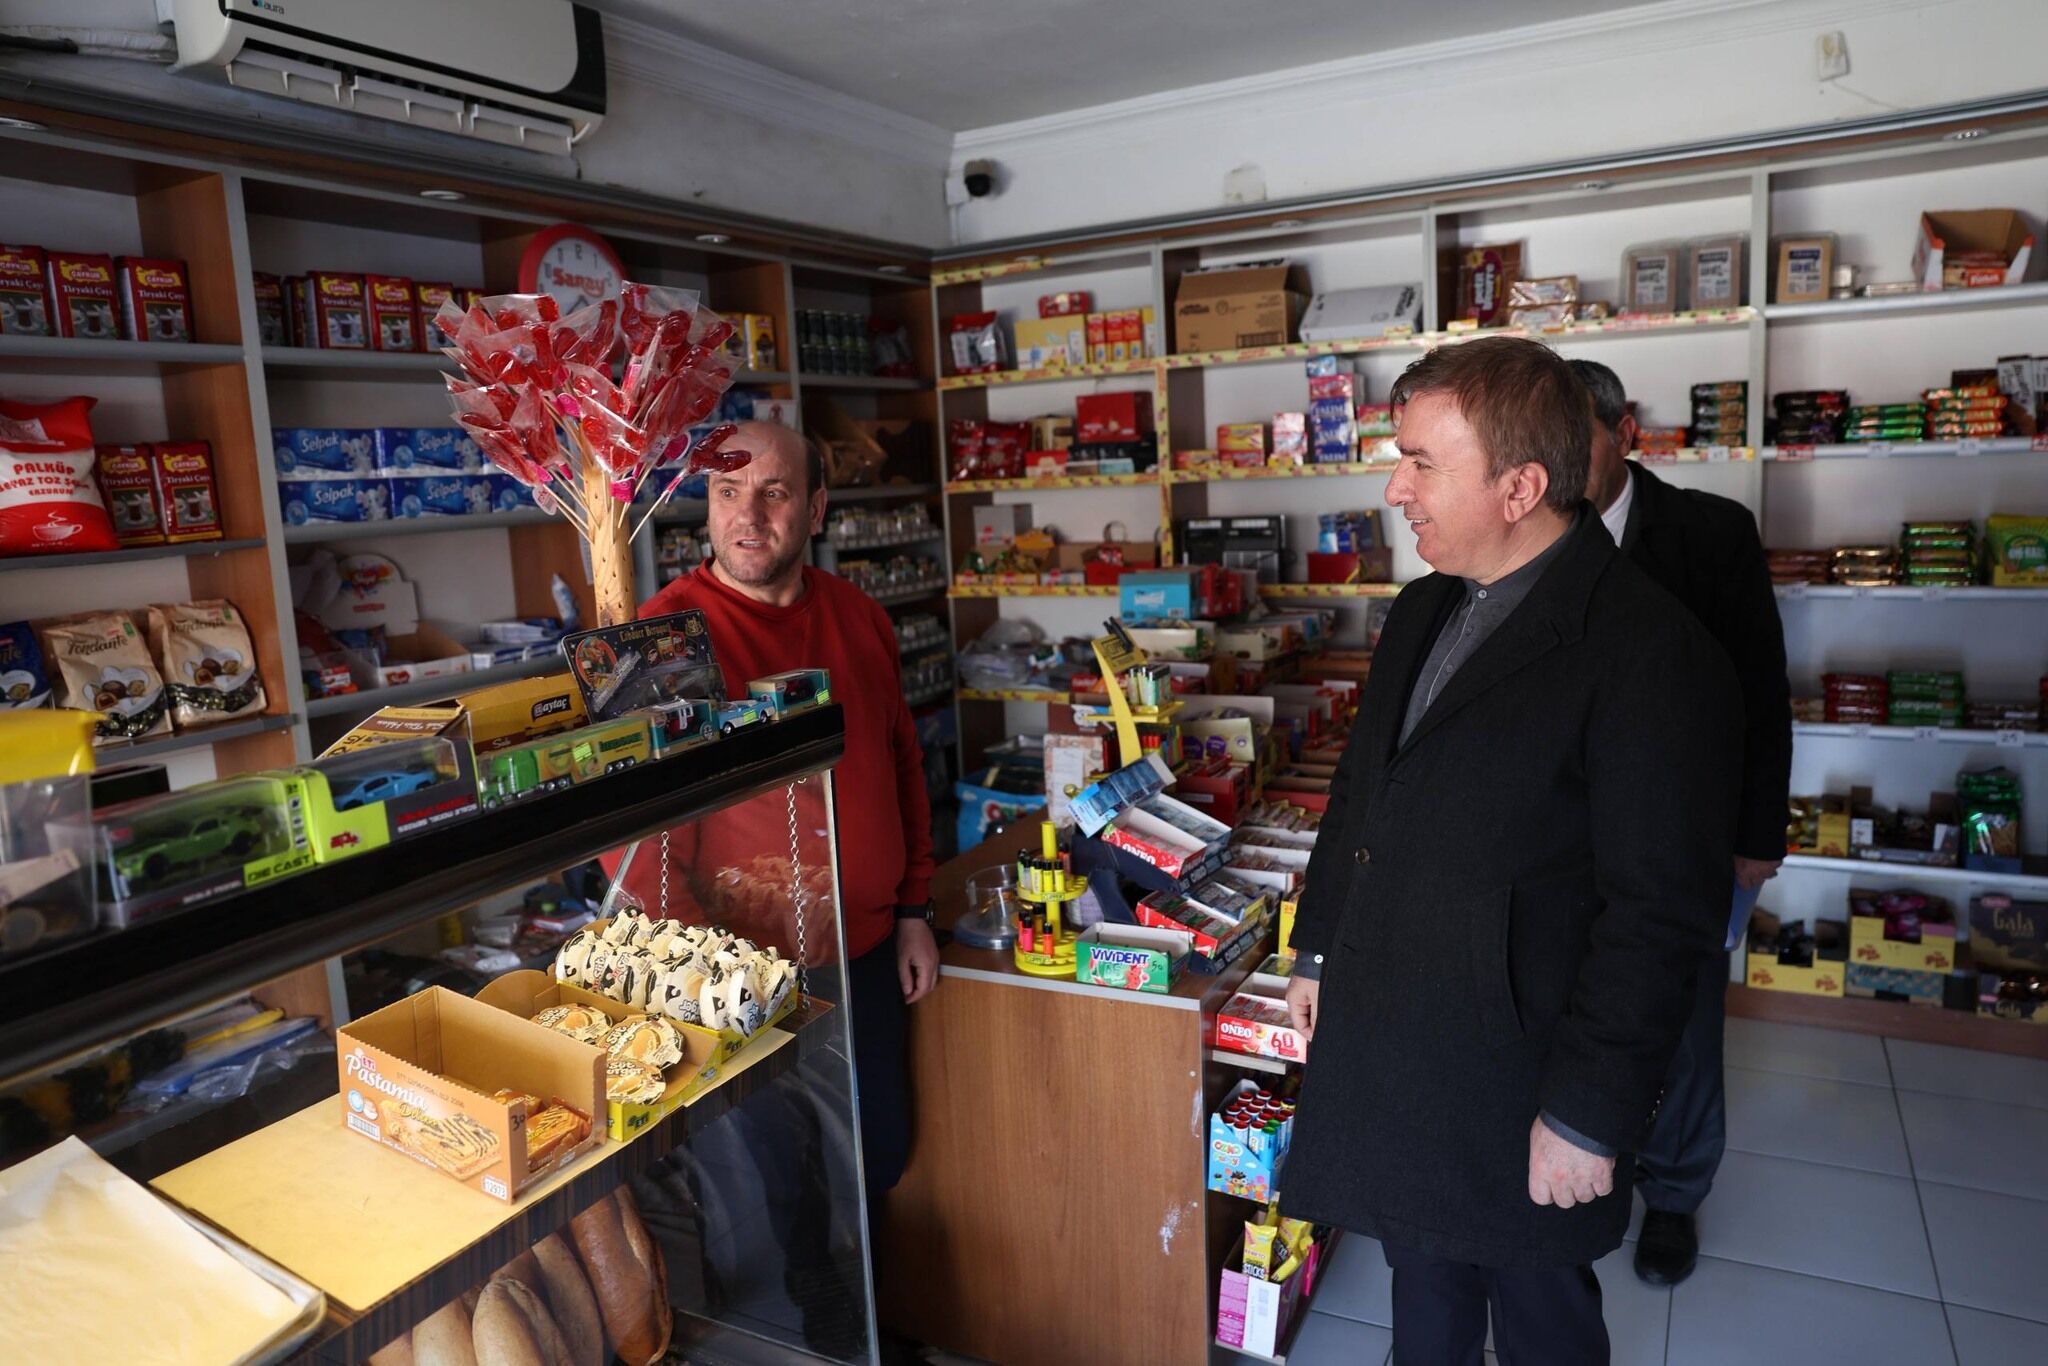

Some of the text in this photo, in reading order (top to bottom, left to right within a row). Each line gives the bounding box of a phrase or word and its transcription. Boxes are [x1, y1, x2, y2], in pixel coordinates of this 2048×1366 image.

[301, 431, 339, 453] Selpak
[418, 432, 453, 452] Selpak
[13, 461, 75, 475] PALKÜP
[37, 477, 61, 485] TOZ
[427, 480, 463, 500] Selpak
[29, 488, 73, 496] ERZURUM
[314, 483, 355, 505] Selpak
[67, 636, 129, 656] Fondante
[248, 855, 310, 882] DIE CAST
[1220, 1022, 1252, 1038] ONEO
[1271, 1031, 1295, 1049] 60
[606, 1068, 644, 1076] urger
[345, 1054, 429, 1111] Pastamia
